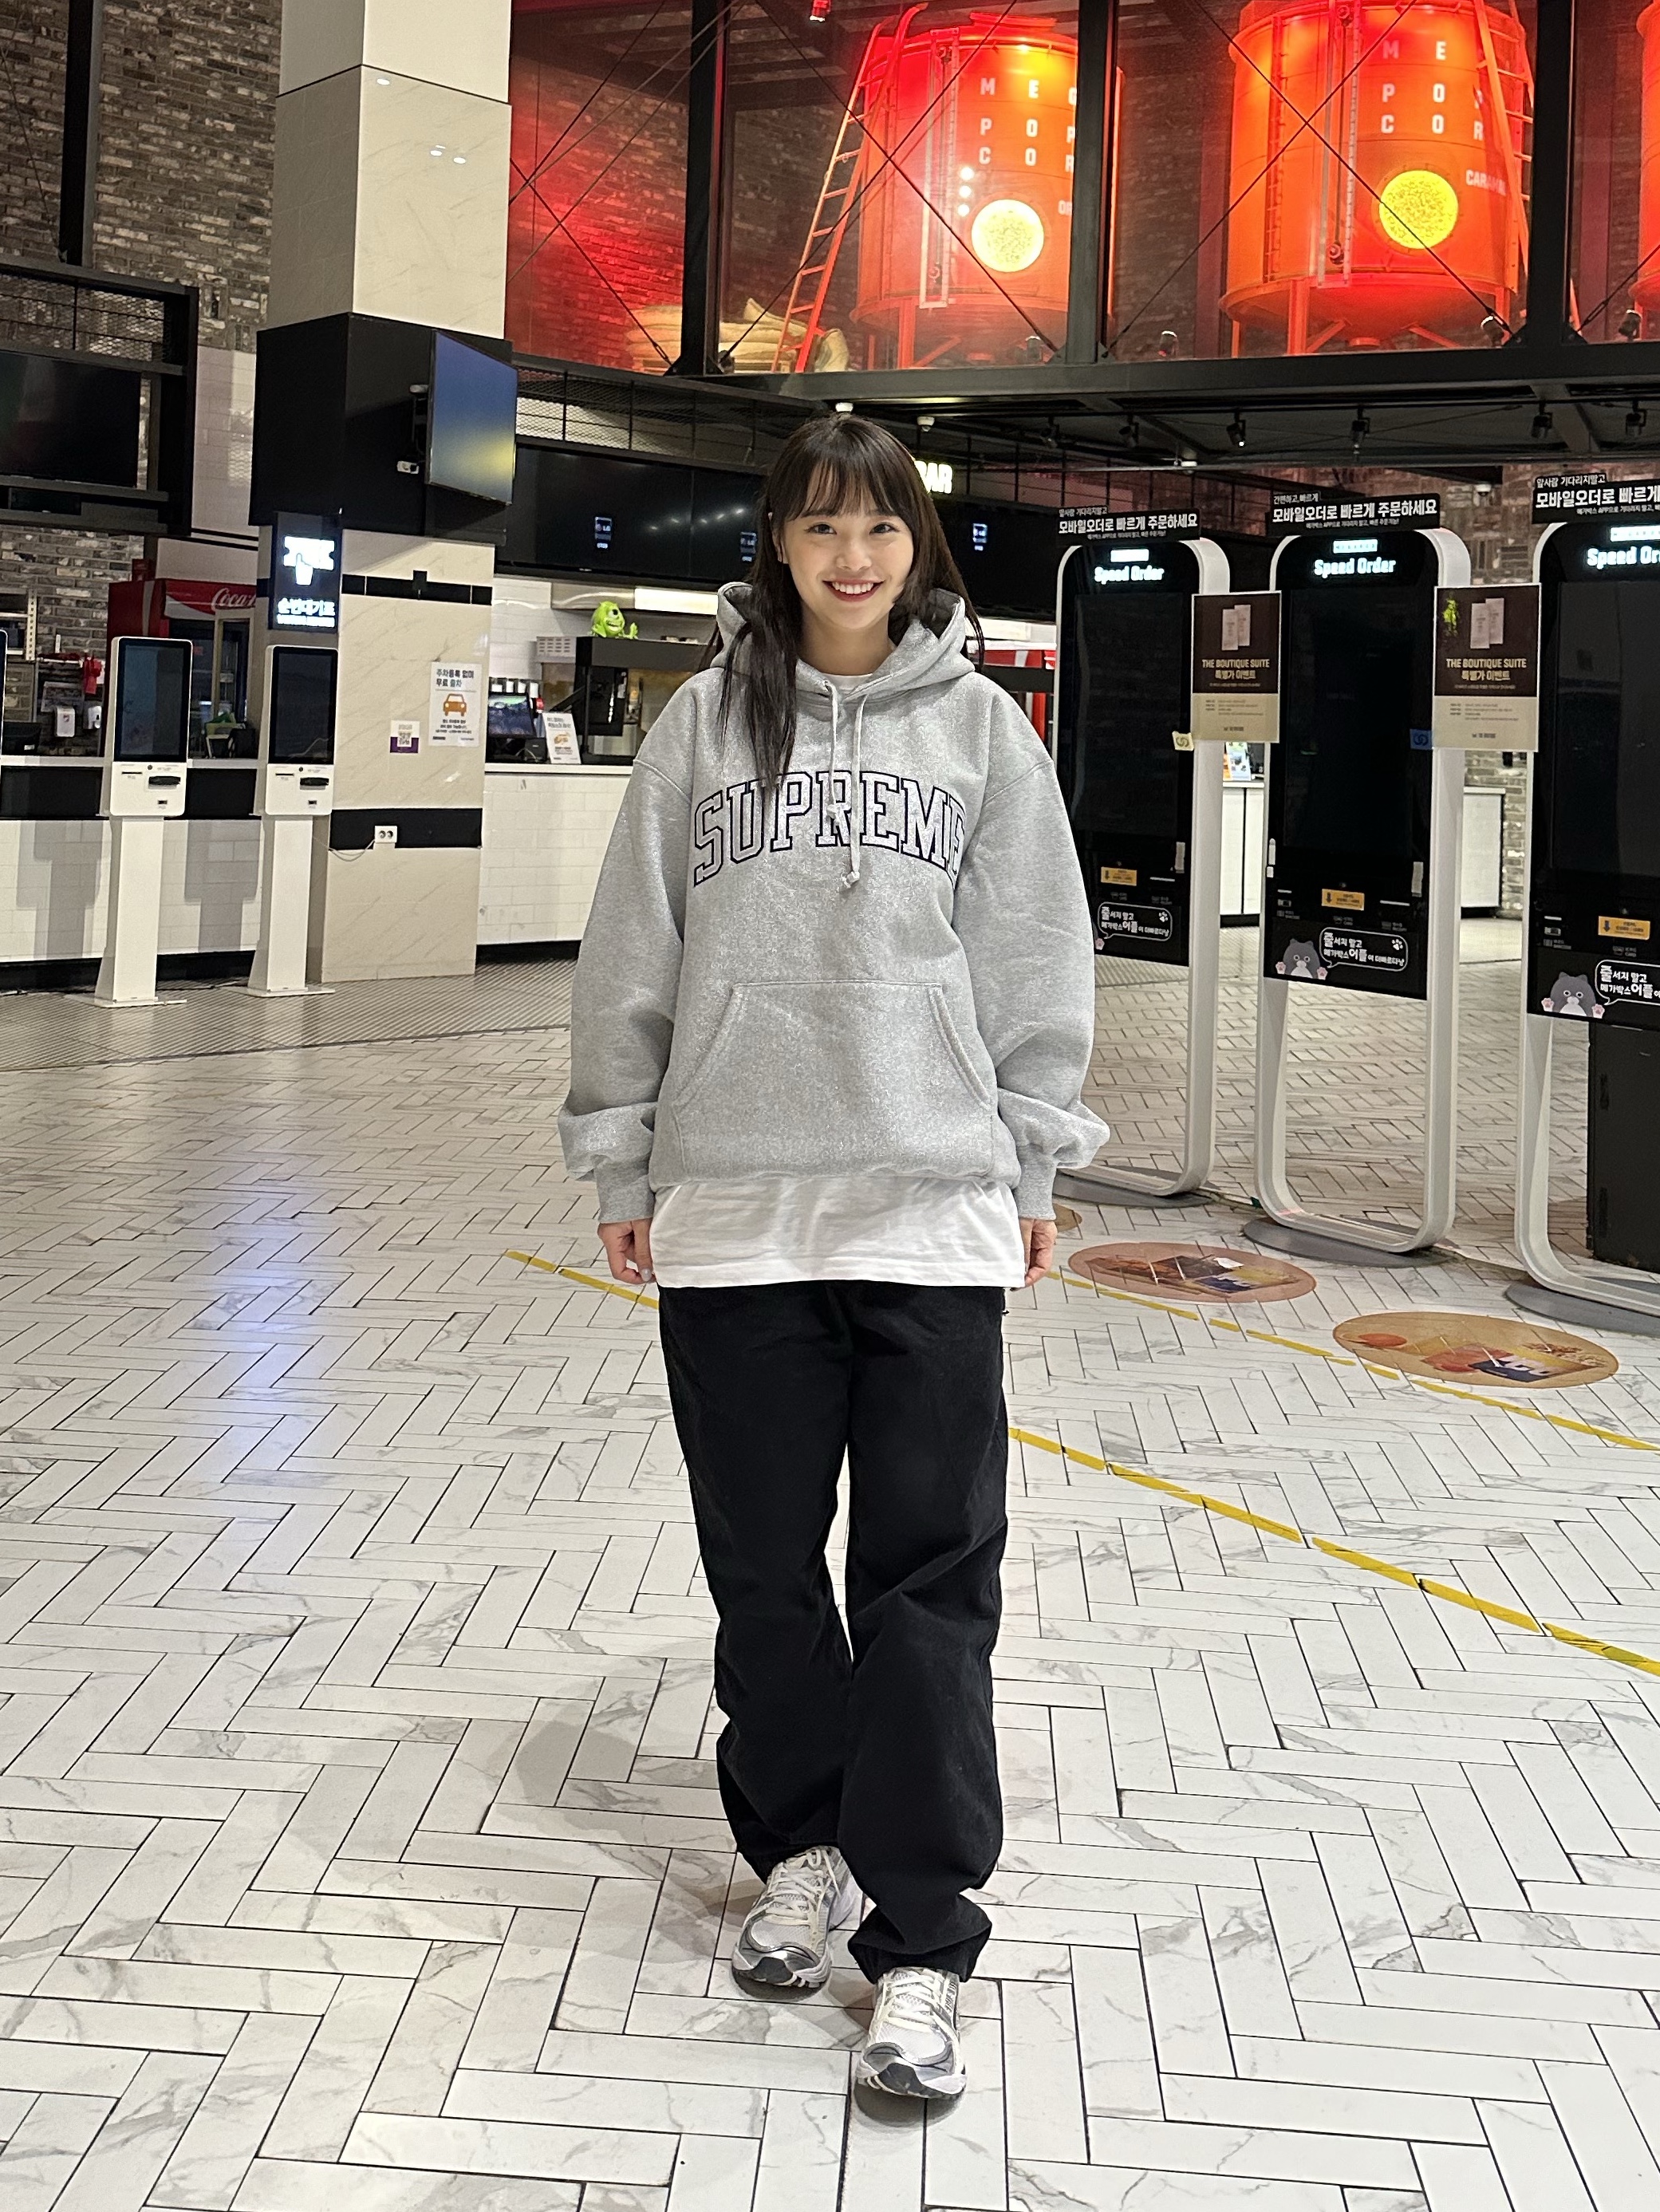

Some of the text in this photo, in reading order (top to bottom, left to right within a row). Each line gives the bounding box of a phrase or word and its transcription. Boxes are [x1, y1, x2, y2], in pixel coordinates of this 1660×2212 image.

[1535, 484, 1660, 508] 모바일오더로 빠르게
[1272, 499, 1437, 522] 모바일오더로 빠르게 주문하세요
[1059, 512, 1198, 534] 모바일오더로 빠르게 주문하세요
[1314, 556, 1397, 578] Speed Order
[1587, 546, 1638, 570] Speed
[1094, 564, 1165, 585] Speed Order
[1201, 659, 1270, 668] THE BOUTIQUE SUITE
[1445, 658, 1528, 669] THE BOUTIQUE SUITE
[693, 769, 967, 889] SUPREME
